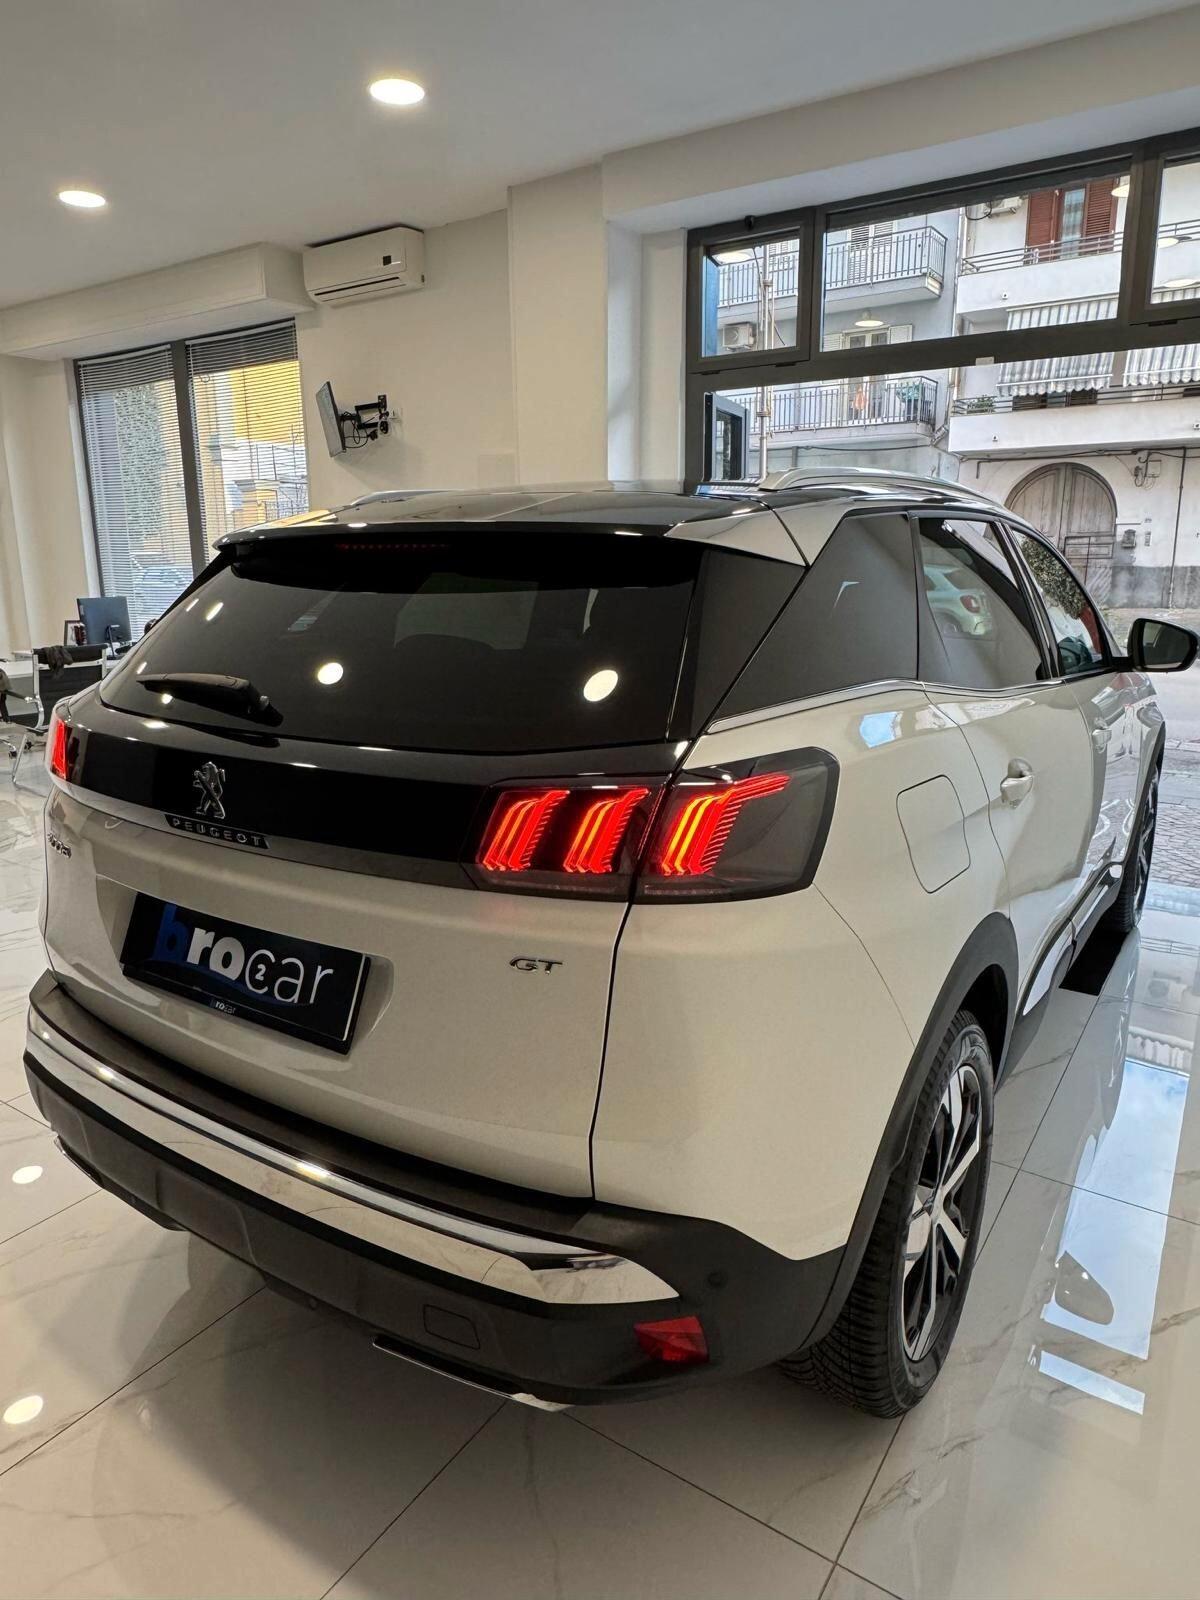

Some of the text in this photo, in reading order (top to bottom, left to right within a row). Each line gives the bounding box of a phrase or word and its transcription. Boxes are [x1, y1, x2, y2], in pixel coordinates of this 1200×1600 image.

[172, 817, 261, 846] PEUGEOT
[255, 963, 266, 981] 2
[509, 956, 563, 975] GT
